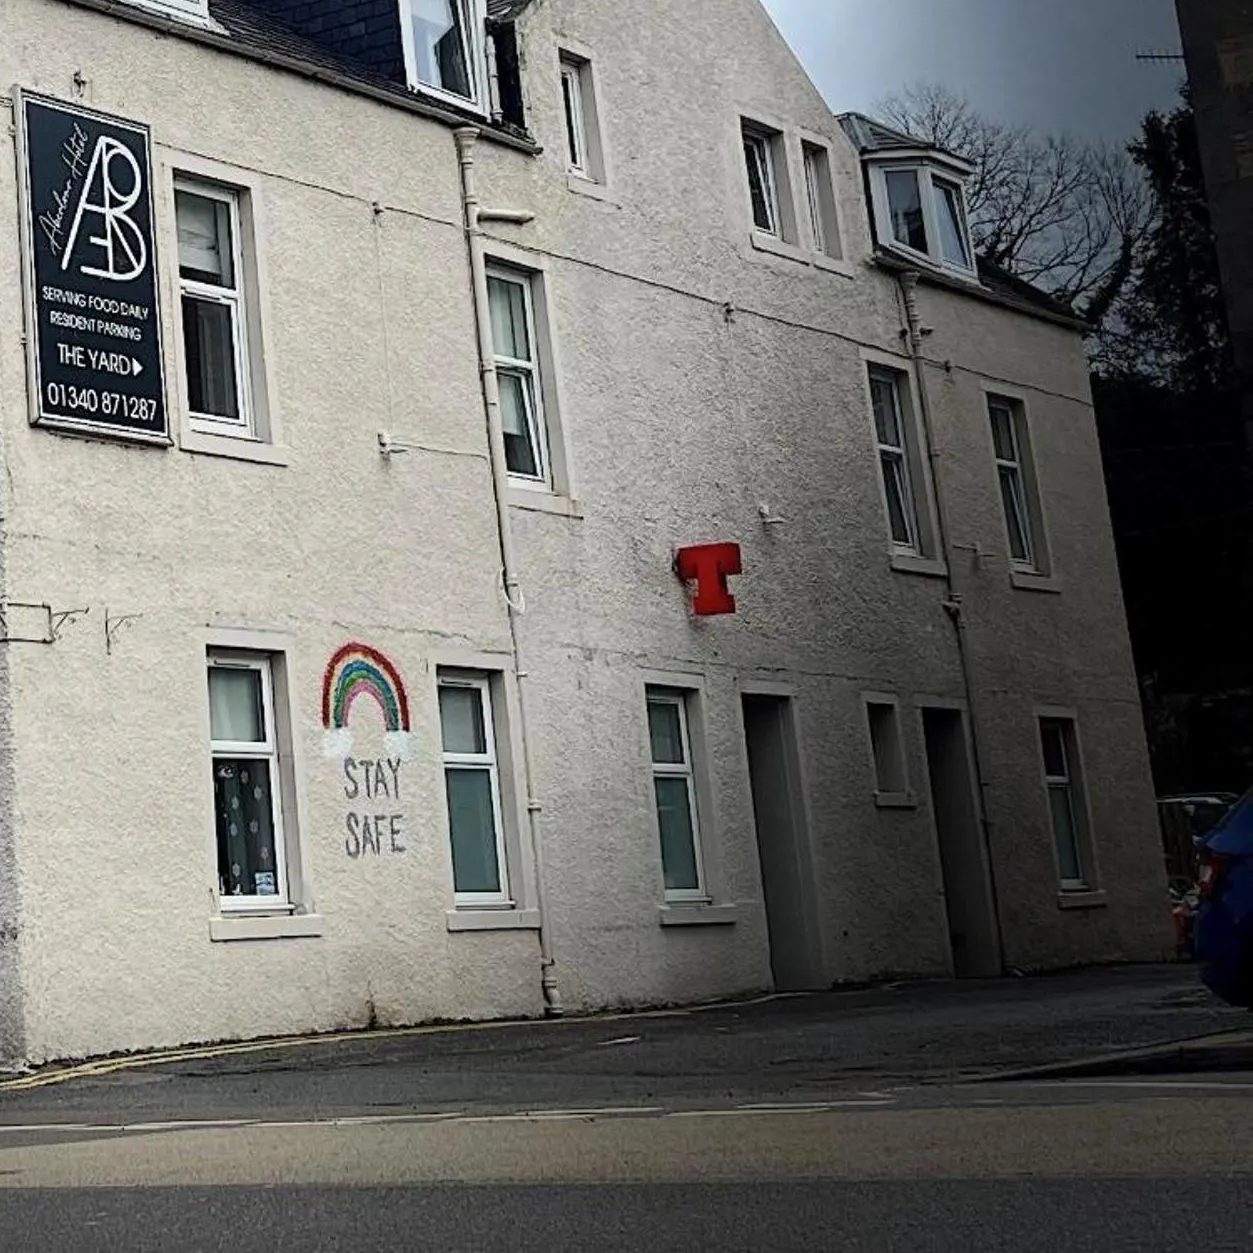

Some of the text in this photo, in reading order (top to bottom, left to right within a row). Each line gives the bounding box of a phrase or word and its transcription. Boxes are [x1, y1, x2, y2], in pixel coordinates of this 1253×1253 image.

[61, 121, 89, 180] Hotel
[42, 285, 149, 321] SERVING FOOD DAILY
[49, 310, 142, 341] RESIDENT PARKING
[56, 343, 131, 375] THE YARD
[47, 382, 157, 422] 01340 871287
[677, 542, 742, 615] T
[344, 757, 401, 799] STAY
[345, 812, 406, 859] SAFE
